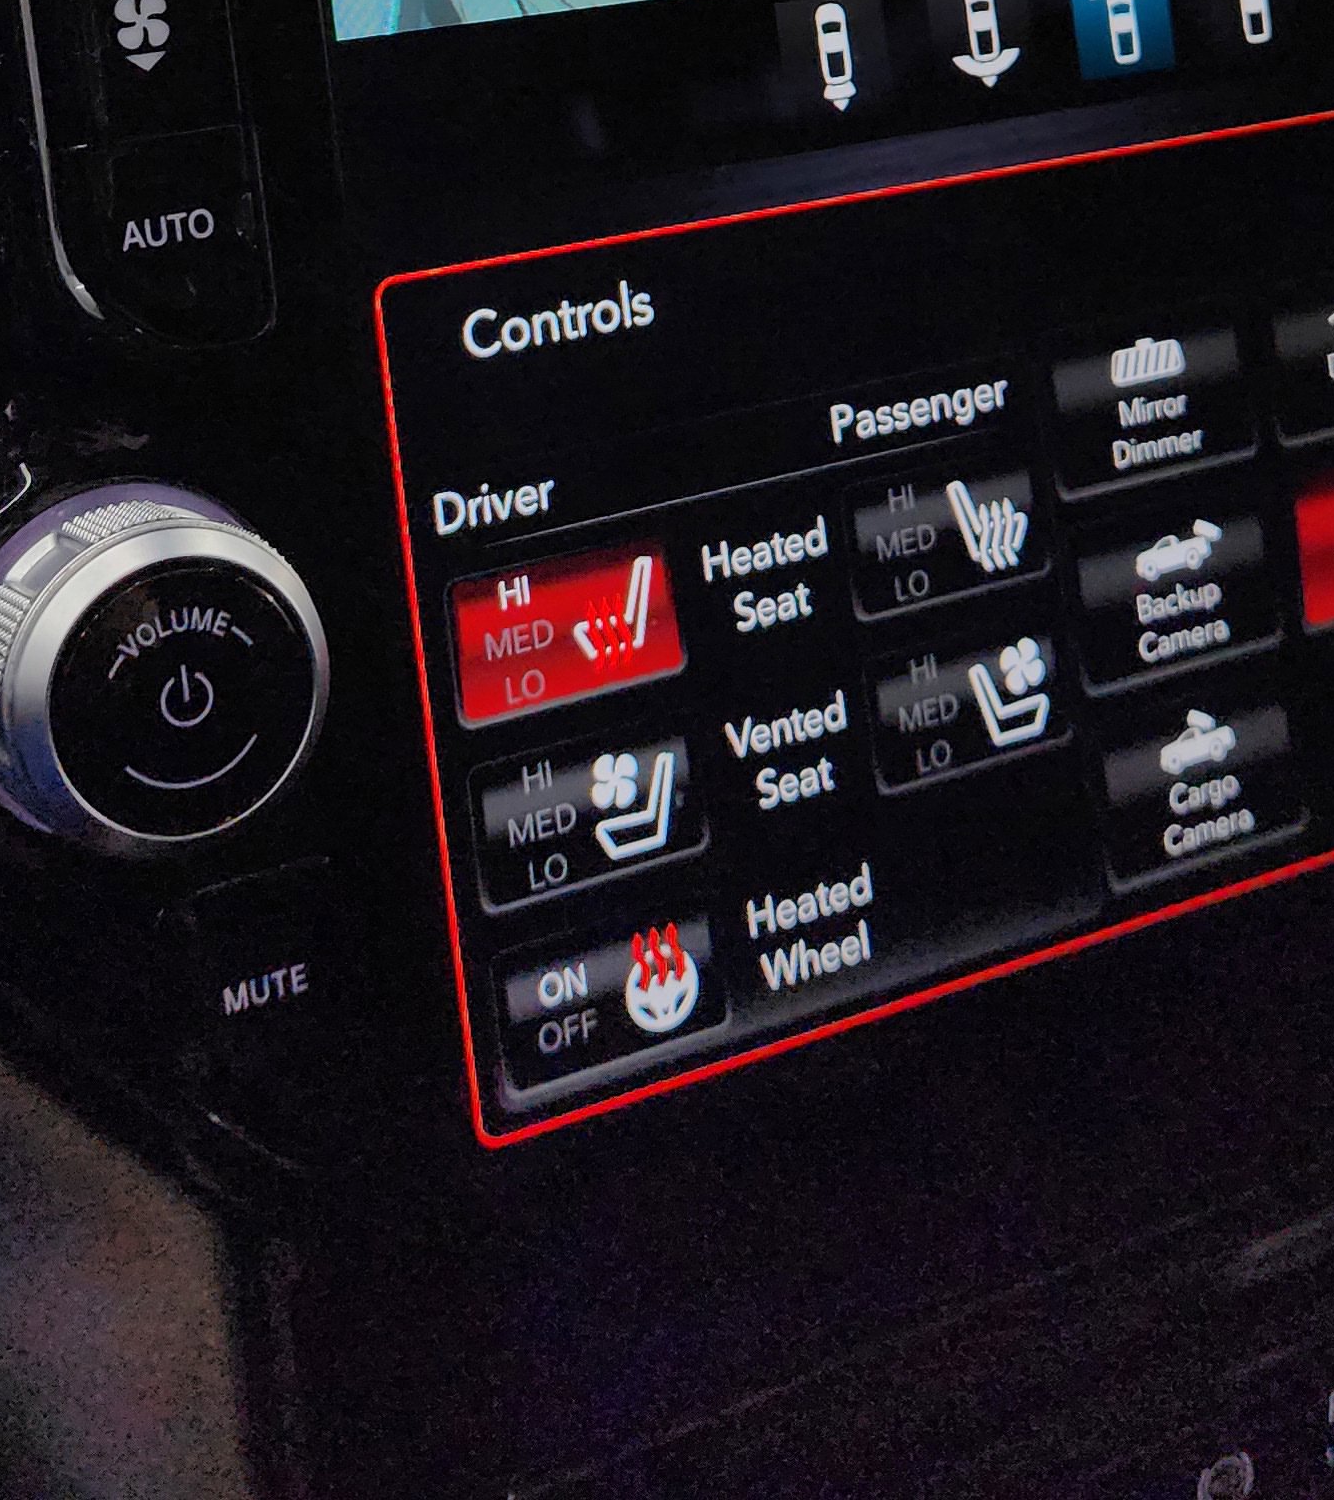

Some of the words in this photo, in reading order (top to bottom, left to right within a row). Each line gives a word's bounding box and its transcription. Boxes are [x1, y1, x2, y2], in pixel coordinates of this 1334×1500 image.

[122, 207, 215, 252] AUTO
[461, 279, 655, 359] Controls
[830, 378, 1008, 444] Passenger
[1118, 392, 1187, 429] Mirror
[1112, 428, 1204, 471] Dimmer
[432, 479, 555, 536] Driver
[887, 485, 916, 512] HI
[701, 515, 828, 582] Heated
[876, 524, 936, 562] MED
[498, 575, 531, 611] HI
[733, 583, 813, 633] Seat
[895, 570, 930, 601] LO
[1135, 582, 1223, 626] Backup
[119, 606, 232, 660] VOLUME
[484, 619, 554, 662] MED
[1138, 618, 1230, 664] Camera
[504, 669, 545, 706] LO
[911, 654, 938, 684] HI
[725, 689, 849, 759] Vented
[897, 694, 959, 733] MED
[522, 760, 553, 794] HI
[915, 739, 953, 773] LO
[755, 758, 835, 810] Seat
[1168, 774, 1241, 814] Cargo
[507, 803, 577, 849] MED
[1163, 808, 1255, 858] Camera
[528, 852, 569, 892] LO
[746, 862, 873, 940] Heated
[759, 919, 871, 991] Wheel
[223, 962, 310, 1017] MUTE
[538, 963, 587, 1008] ON
[538, 1008, 599, 1054] OFF
